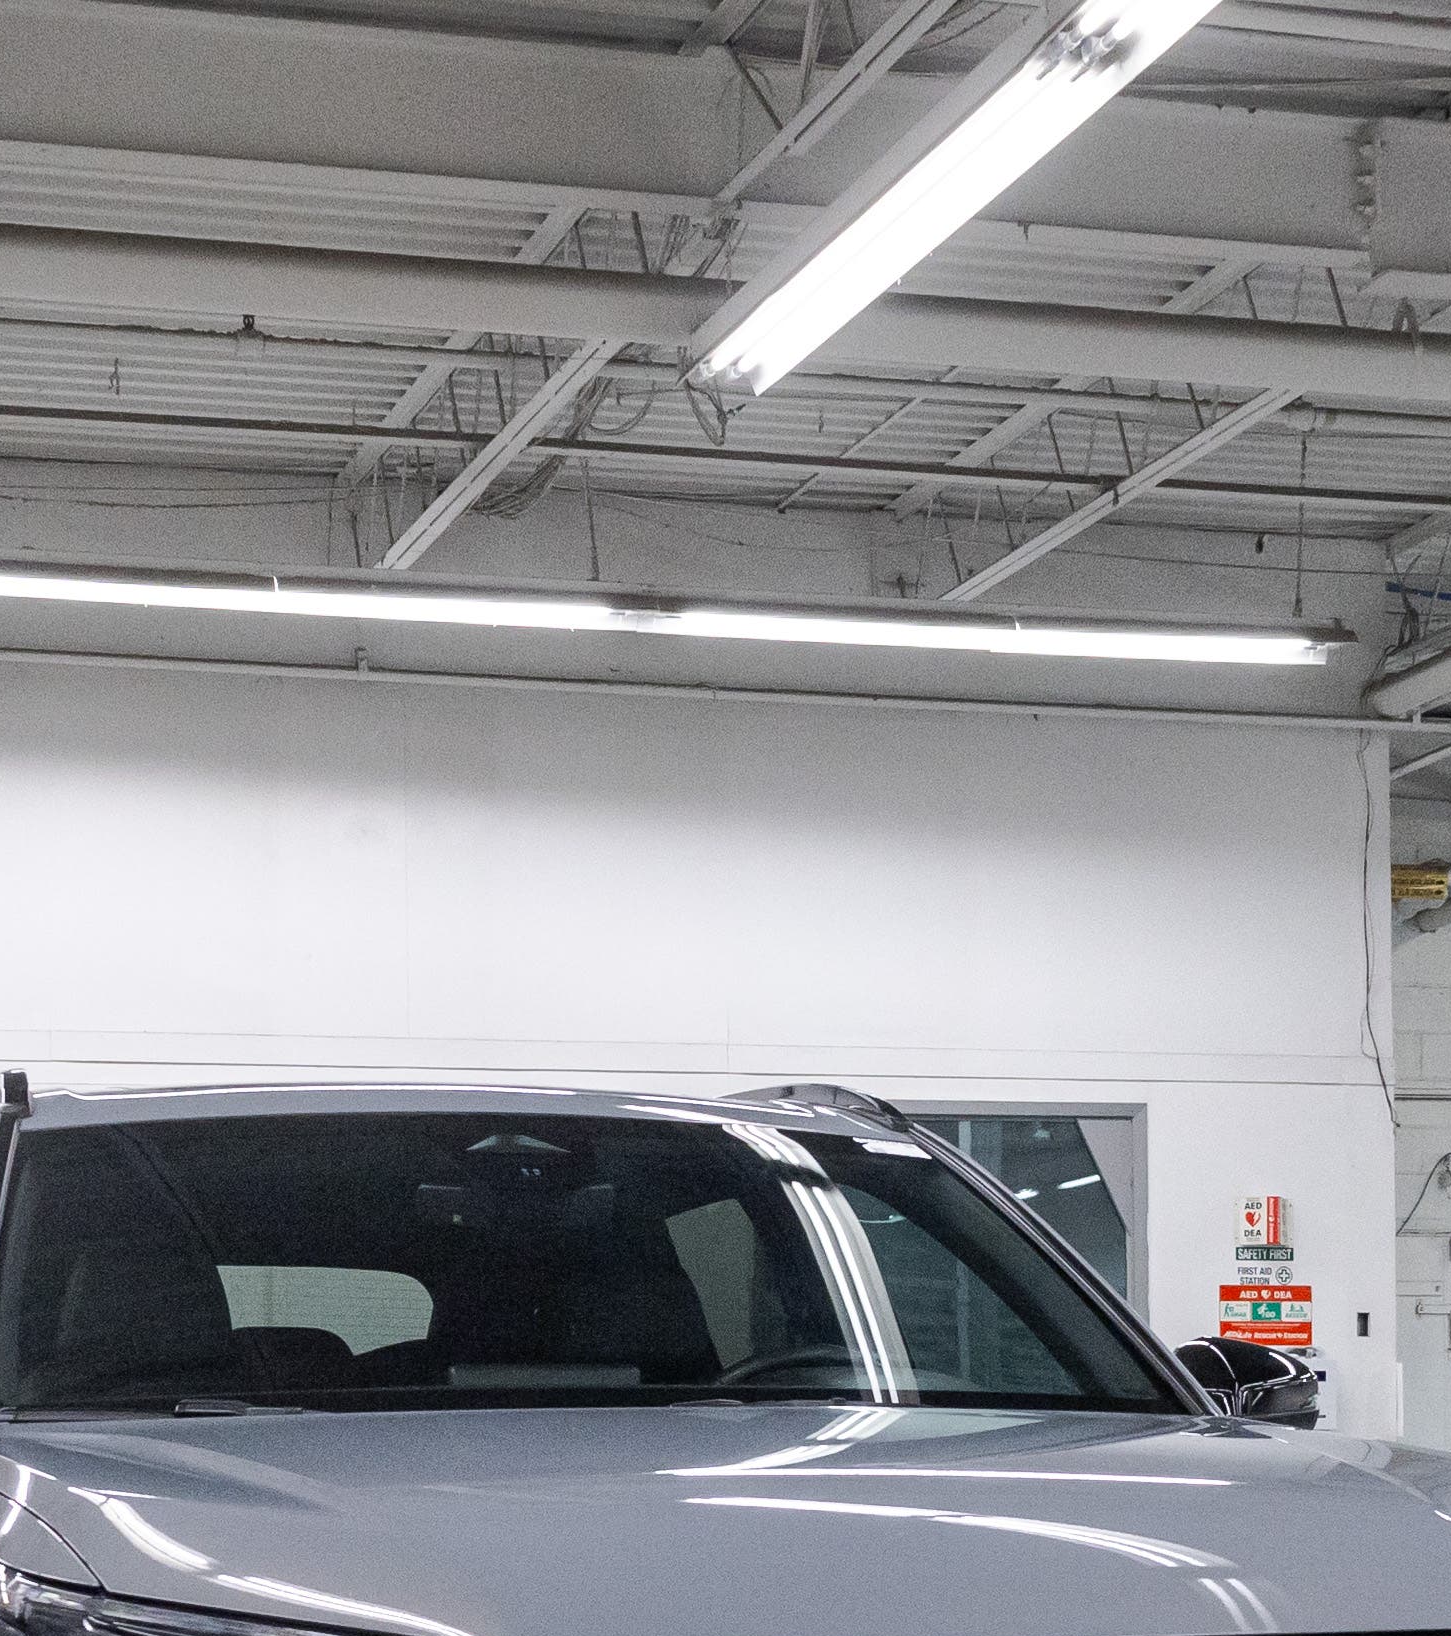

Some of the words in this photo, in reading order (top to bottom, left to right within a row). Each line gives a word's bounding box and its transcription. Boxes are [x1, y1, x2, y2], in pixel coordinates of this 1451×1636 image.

[1244, 1202, 1262, 1210] AED
[1244, 1229, 1262, 1237] DEA
[1237, 1248, 1267, 1260] SAFETY
[1269, 1249, 1292, 1260] FIRST
[1237, 1266, 1258, 1275] FIRST
[1259, 1267, 1272, 1275] AID
[1239, 1276, 1270, 1285] STATION
[1239, 1290, 1259, 1299] AED
[1273, 1290, 1293, 1299] DEA
